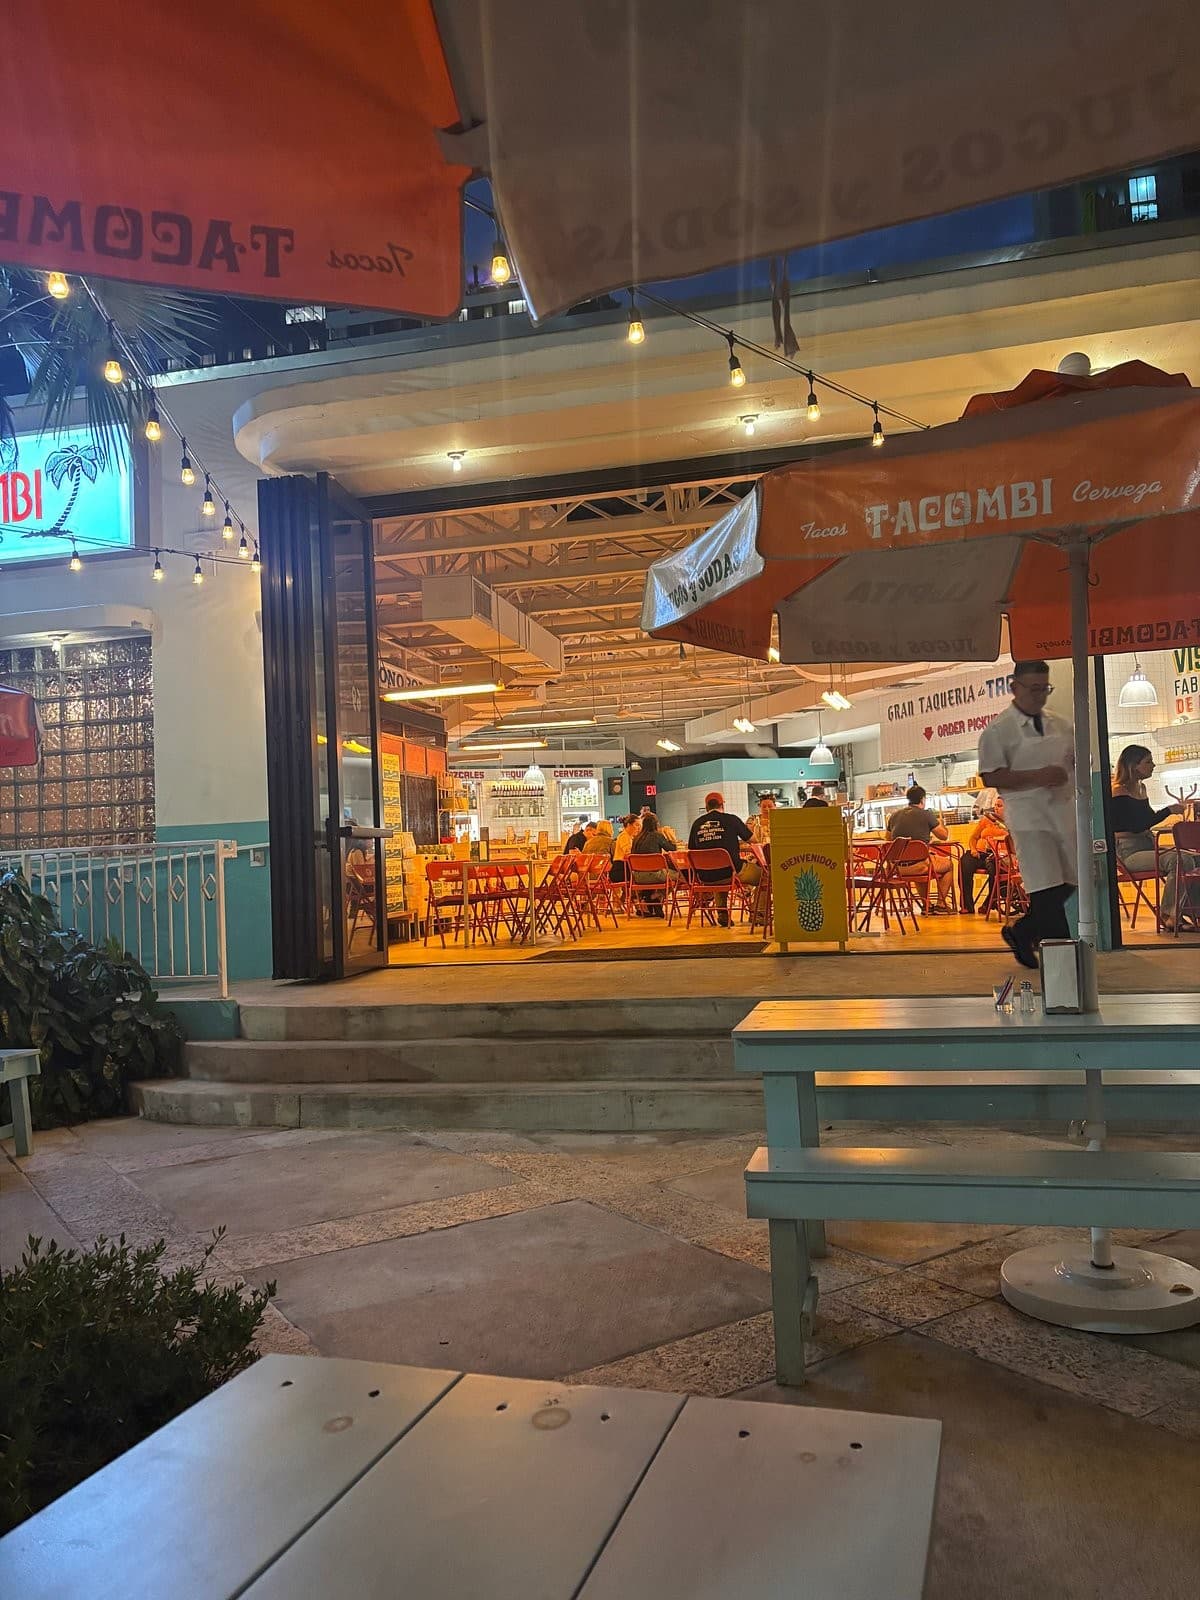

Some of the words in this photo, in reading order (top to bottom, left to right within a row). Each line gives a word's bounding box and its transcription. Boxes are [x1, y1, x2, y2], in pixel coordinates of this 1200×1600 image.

[800, 522, 848, 540] Tacos
[864, 478, 1053, 539] TACOMBI
[1071, 480, 1163, 504] Cerveza
[887, 699, 914, 722] GRAN
[918, 685, 975, 714] TAQUERIA
[1175, 696, 1194, 715] DE
[937, 719, 966, 738] ORDER
[446, 771, 485, 779] ZCALES
[553, 769, 594, 778] CERVEZAS
[780, 852, 838, 871] BIENVENIDOS
